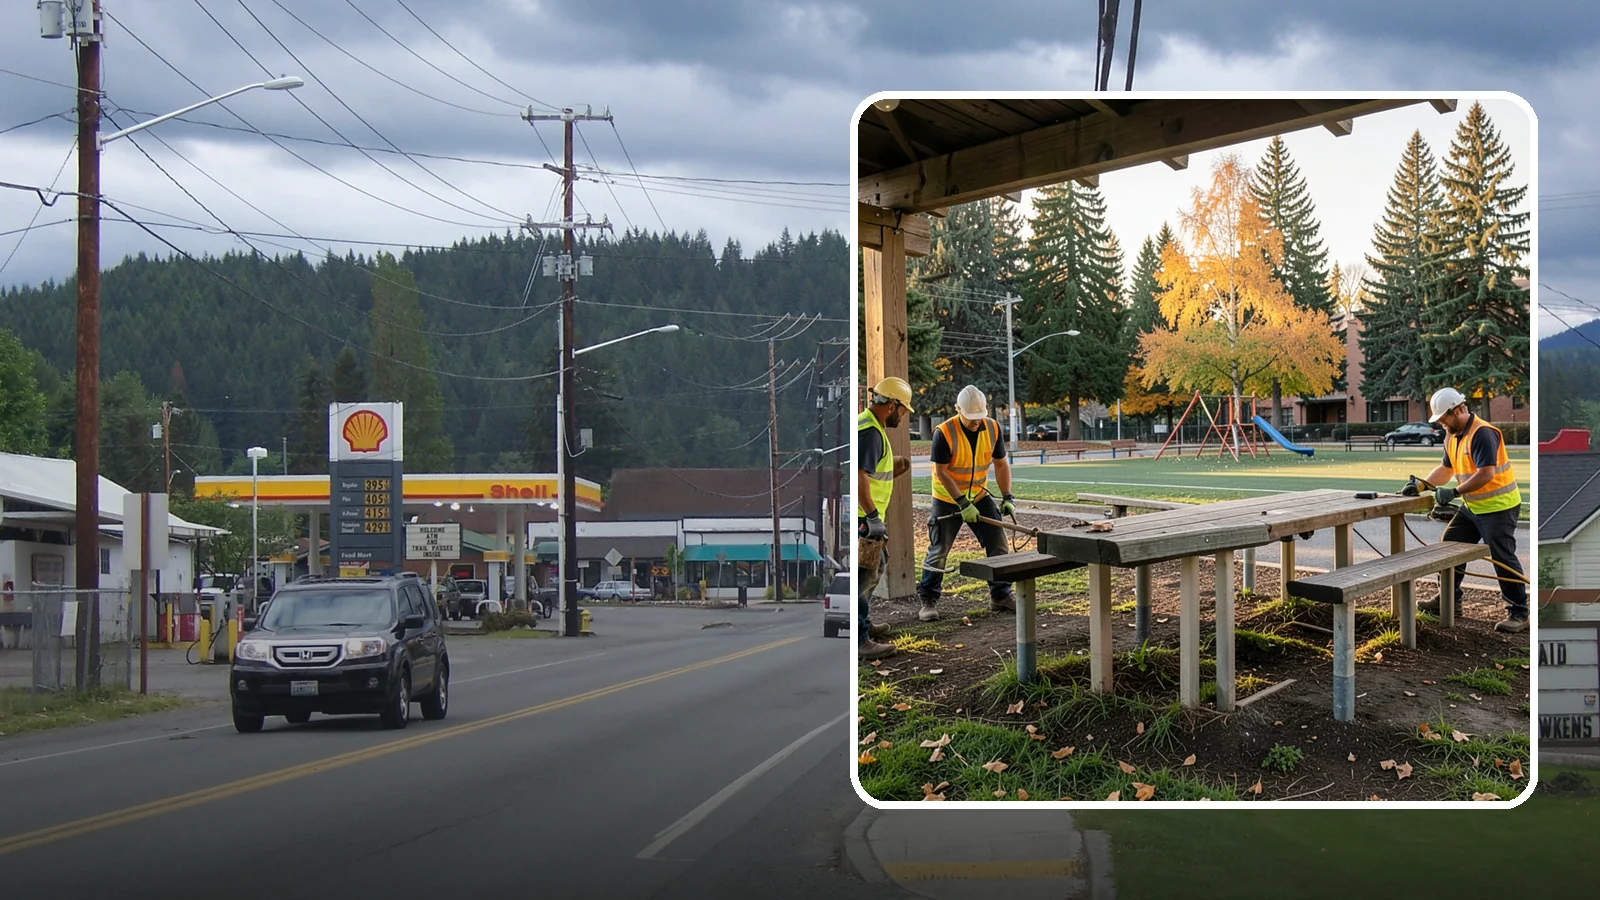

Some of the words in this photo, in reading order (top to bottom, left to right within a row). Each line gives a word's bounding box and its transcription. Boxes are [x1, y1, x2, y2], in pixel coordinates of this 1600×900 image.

[366, 480, 383, 490] 395
[490, 484, 547, 499] Shell
[366, 494, 383, 504] 405
[366, 508, 383, 518] 415
[366, 522, 383, 533] 429
